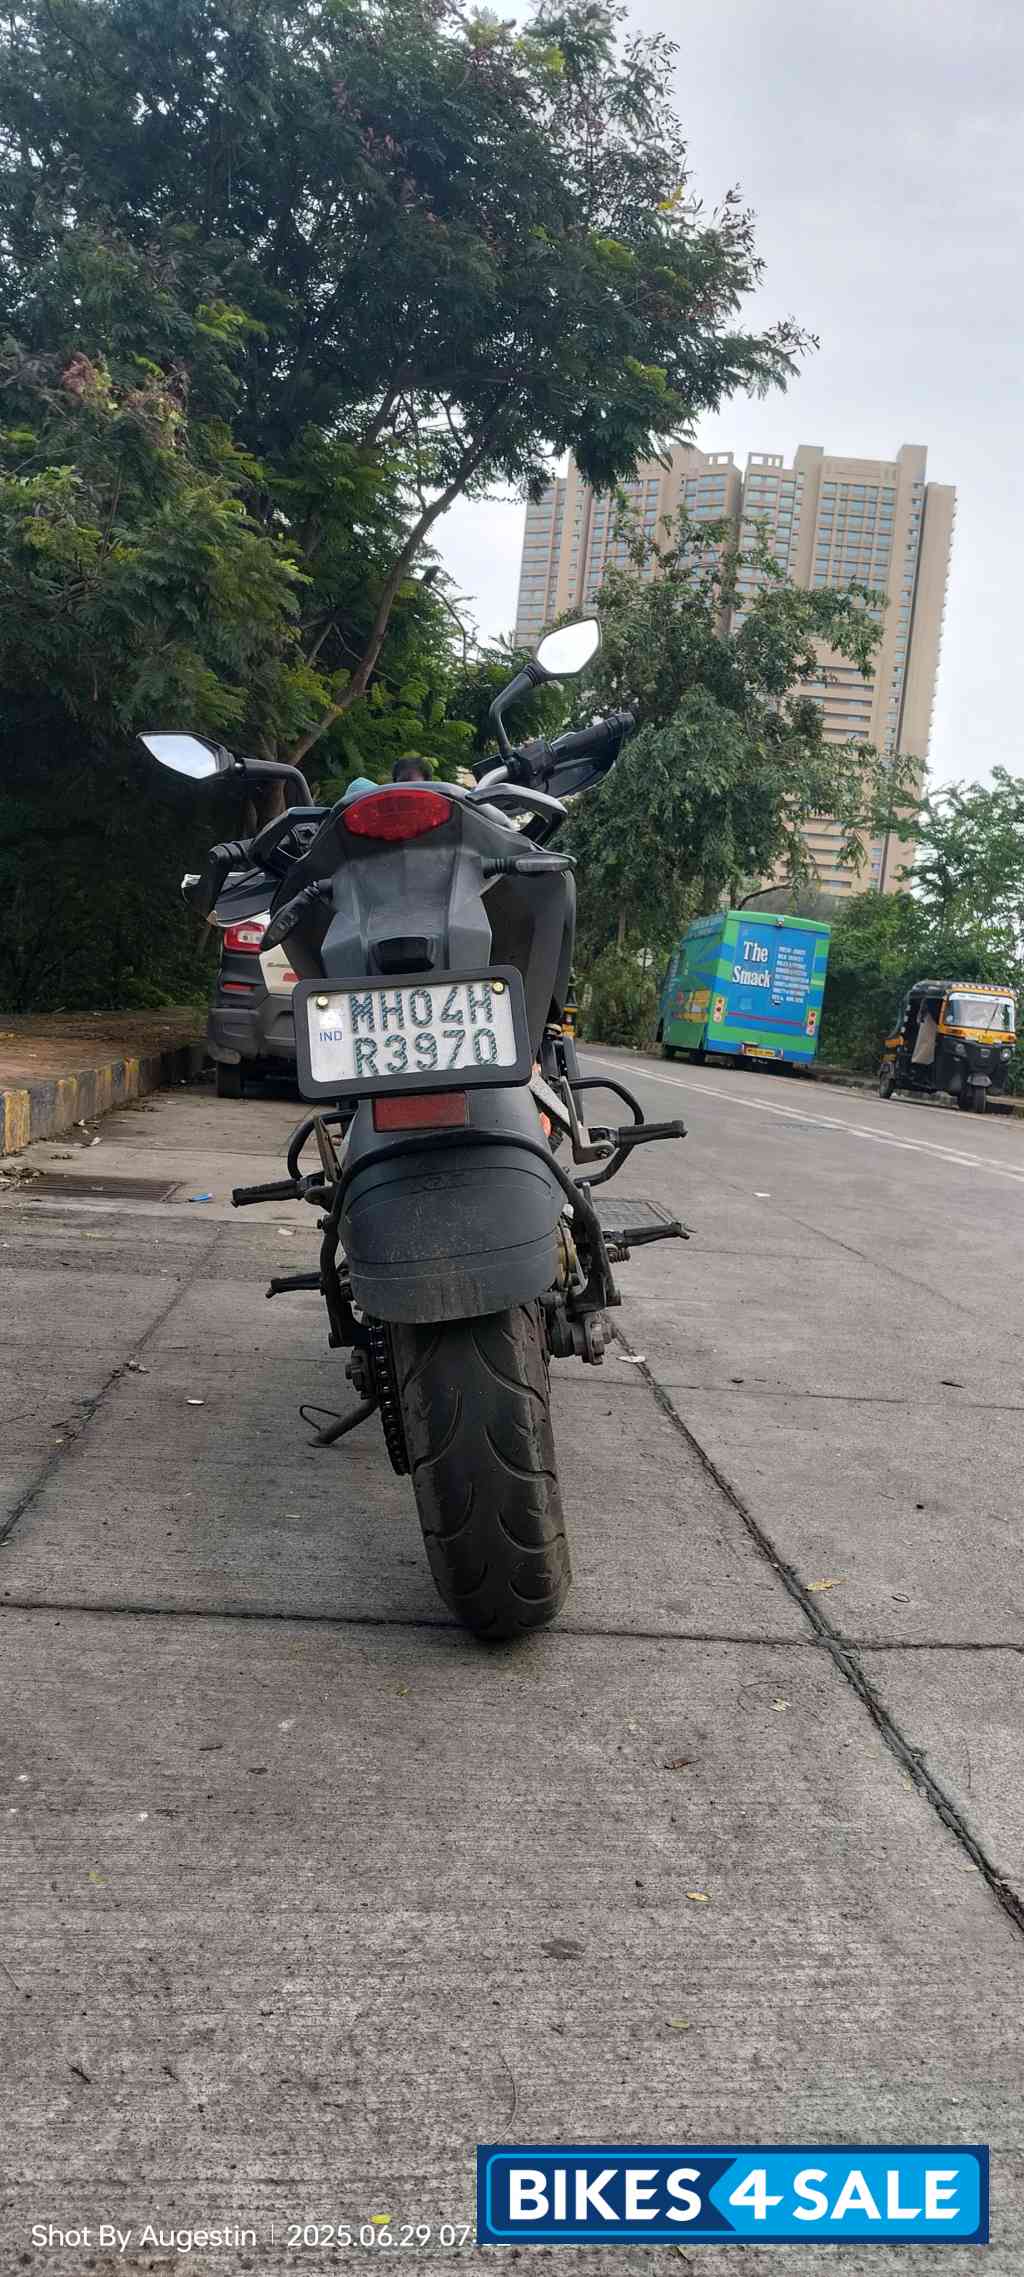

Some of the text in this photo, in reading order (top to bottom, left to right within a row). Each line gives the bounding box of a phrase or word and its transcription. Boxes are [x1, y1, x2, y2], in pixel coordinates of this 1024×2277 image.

[743, 940, 768, 962] The
[732, 965, 772, 988] Smack
[349, 984, 494, 1033] MH04H
[319, 1031, 343, 1042] IND
[353, 1027, 498, 1077] R3970
